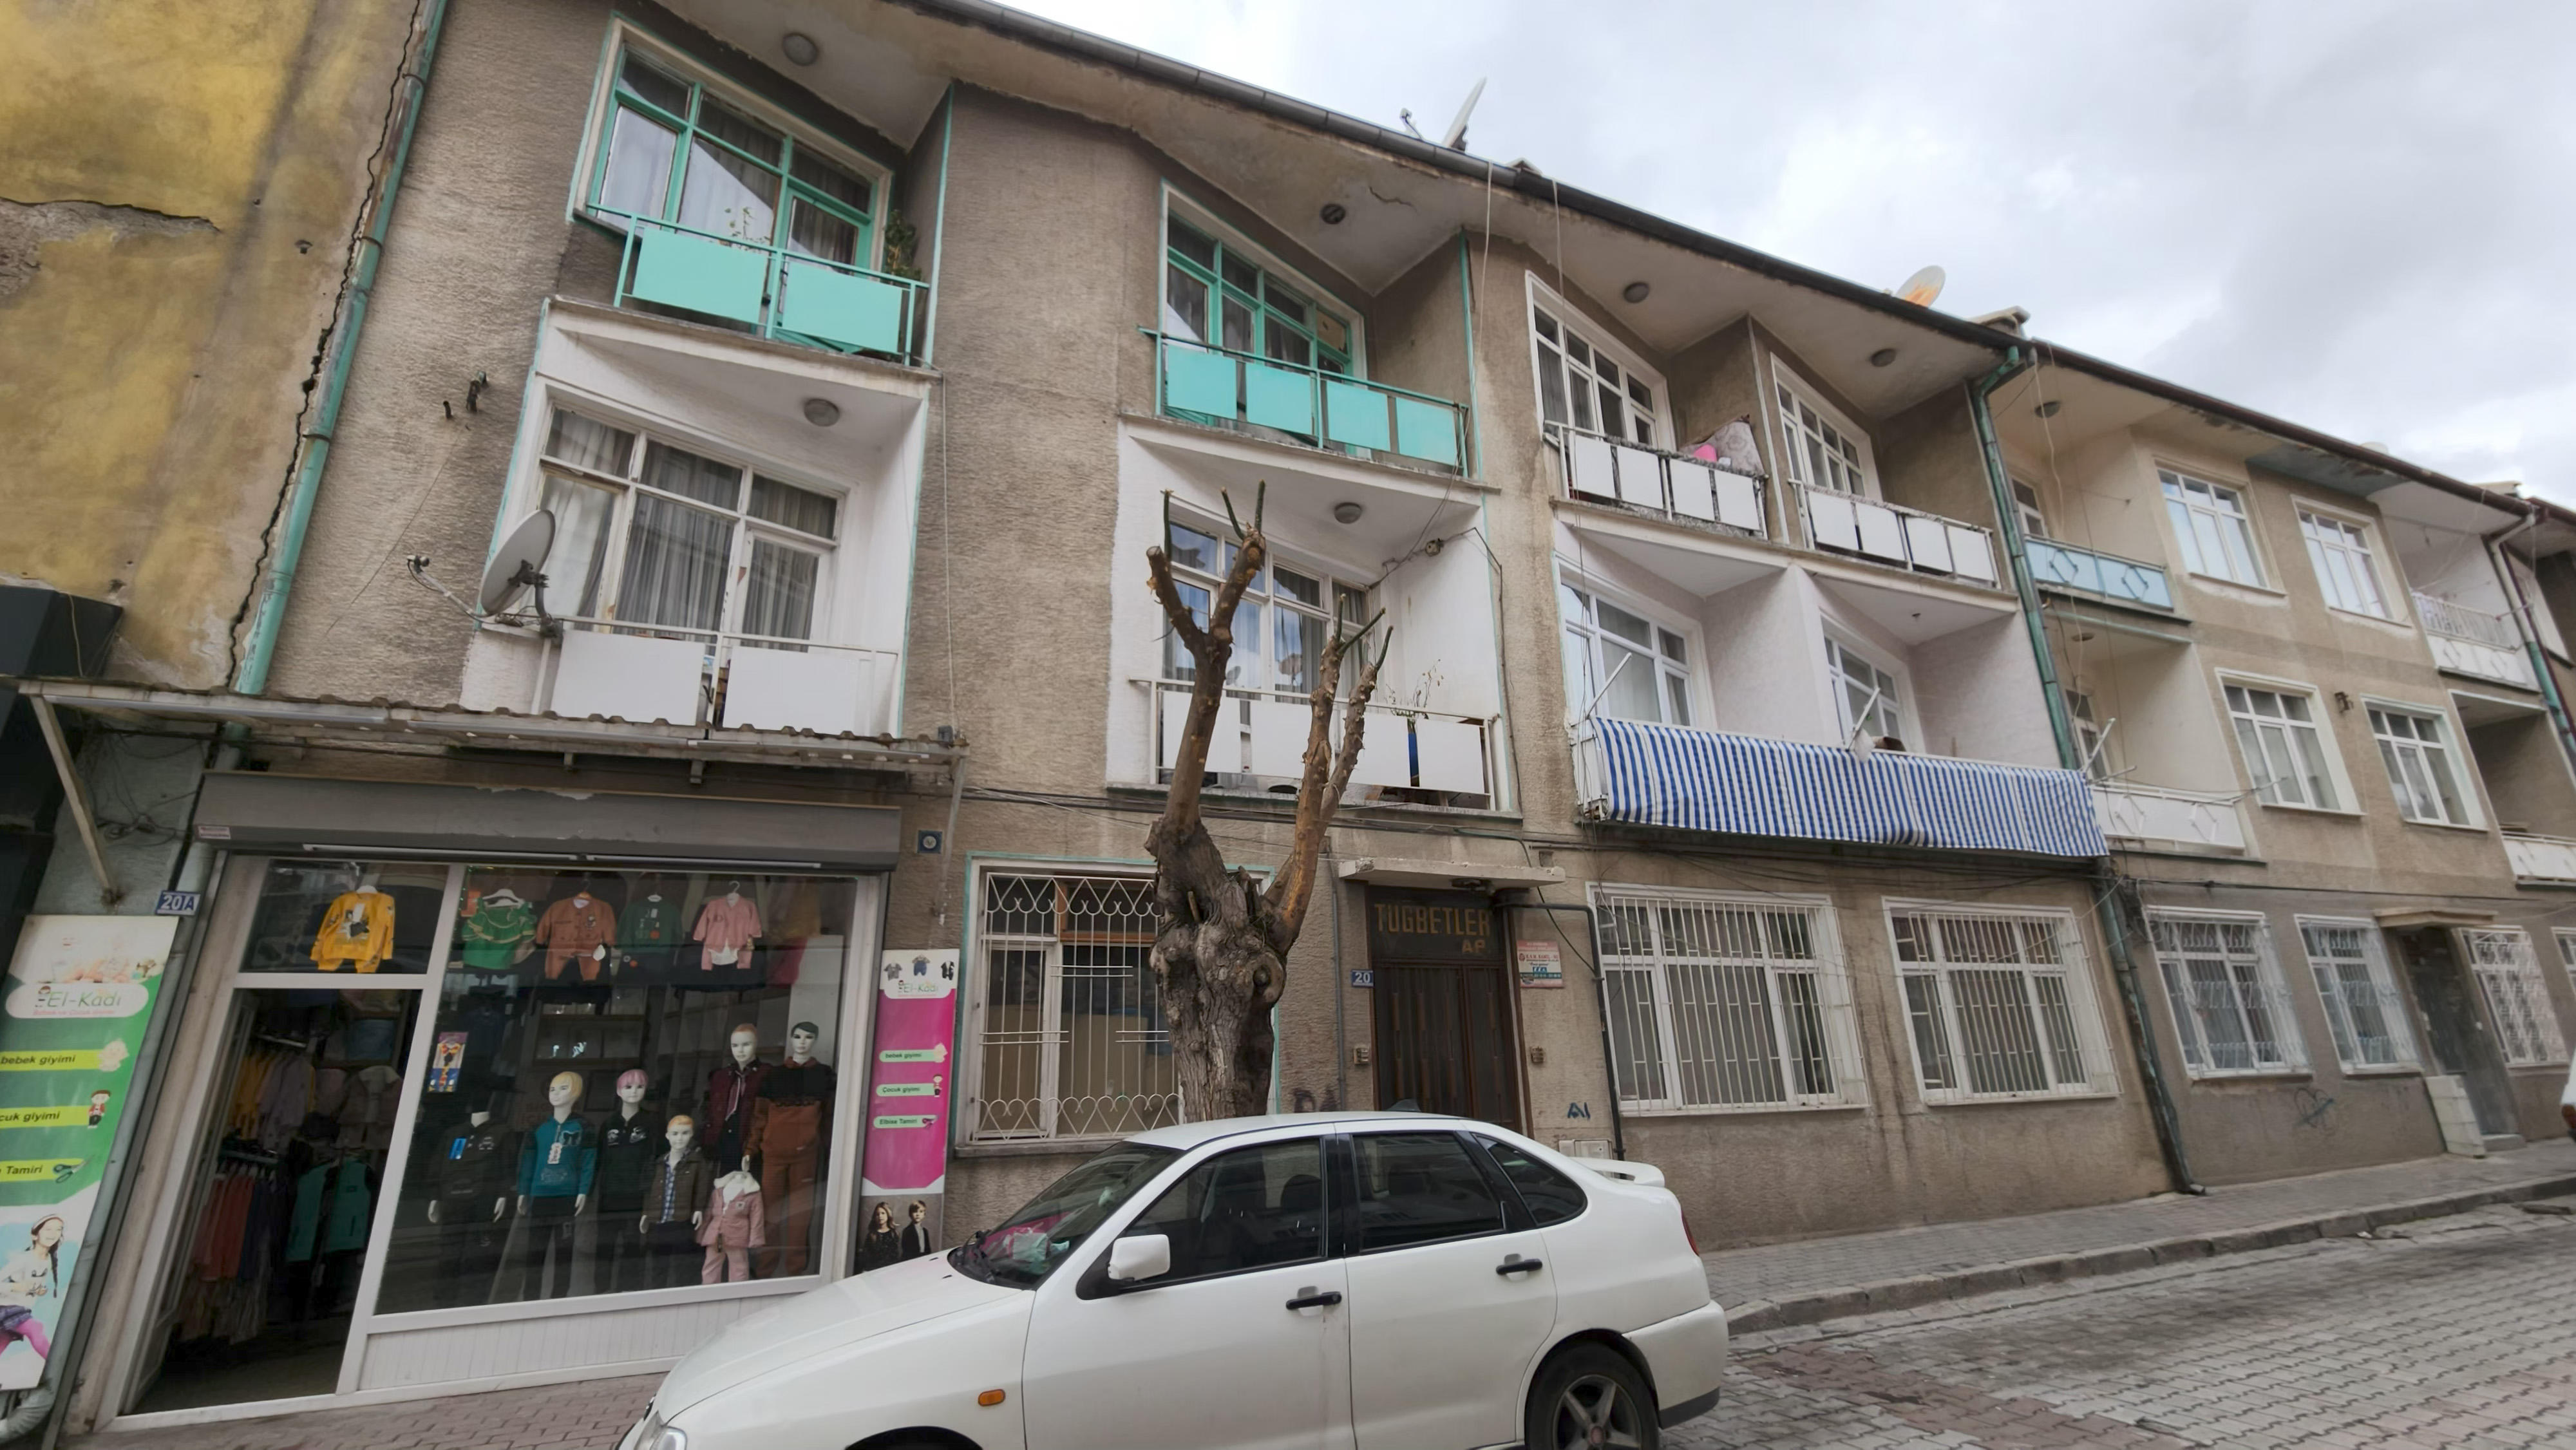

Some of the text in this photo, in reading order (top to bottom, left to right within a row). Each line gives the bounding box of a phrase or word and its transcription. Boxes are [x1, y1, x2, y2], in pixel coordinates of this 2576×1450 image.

[1354, 972, 1370, 983] 20
[0, 1054, 76, 1065] bebek giyimi
[23, 1111, 61, 1122] giyimi
[6, 1165, 43, 1174] Tamiri
